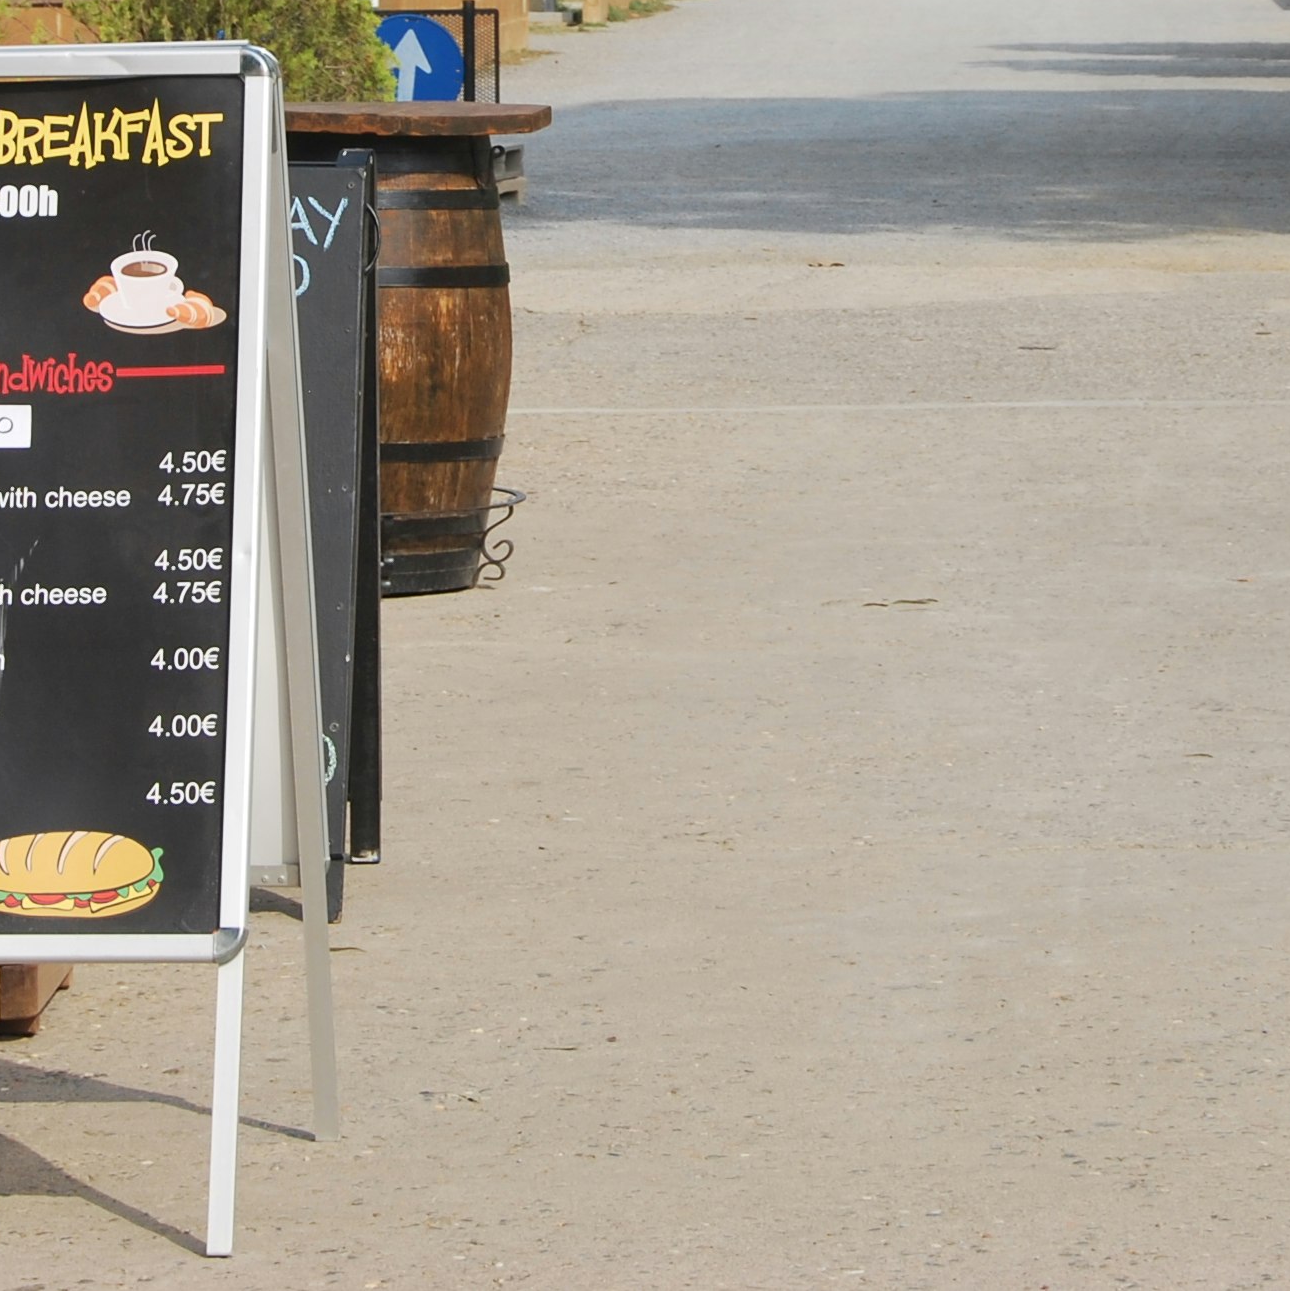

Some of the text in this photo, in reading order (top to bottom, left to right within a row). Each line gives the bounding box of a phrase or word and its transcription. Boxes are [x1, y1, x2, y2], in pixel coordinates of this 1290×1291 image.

[158, 449, 227, 474] 4.50€
[44, 486, 131, 509] cheese
[157, 482, 226, 507] 4.75€
[154, 547, 224, 572] 4.50€
[20, 582, 107, 606] cheese
[152, 580, 222, 604] 4.75€
[150, 646, 220, 671] 4.00€
[148, 713, 218, 738] 4.00€
[145, 780, 216, 805] 4.50€
